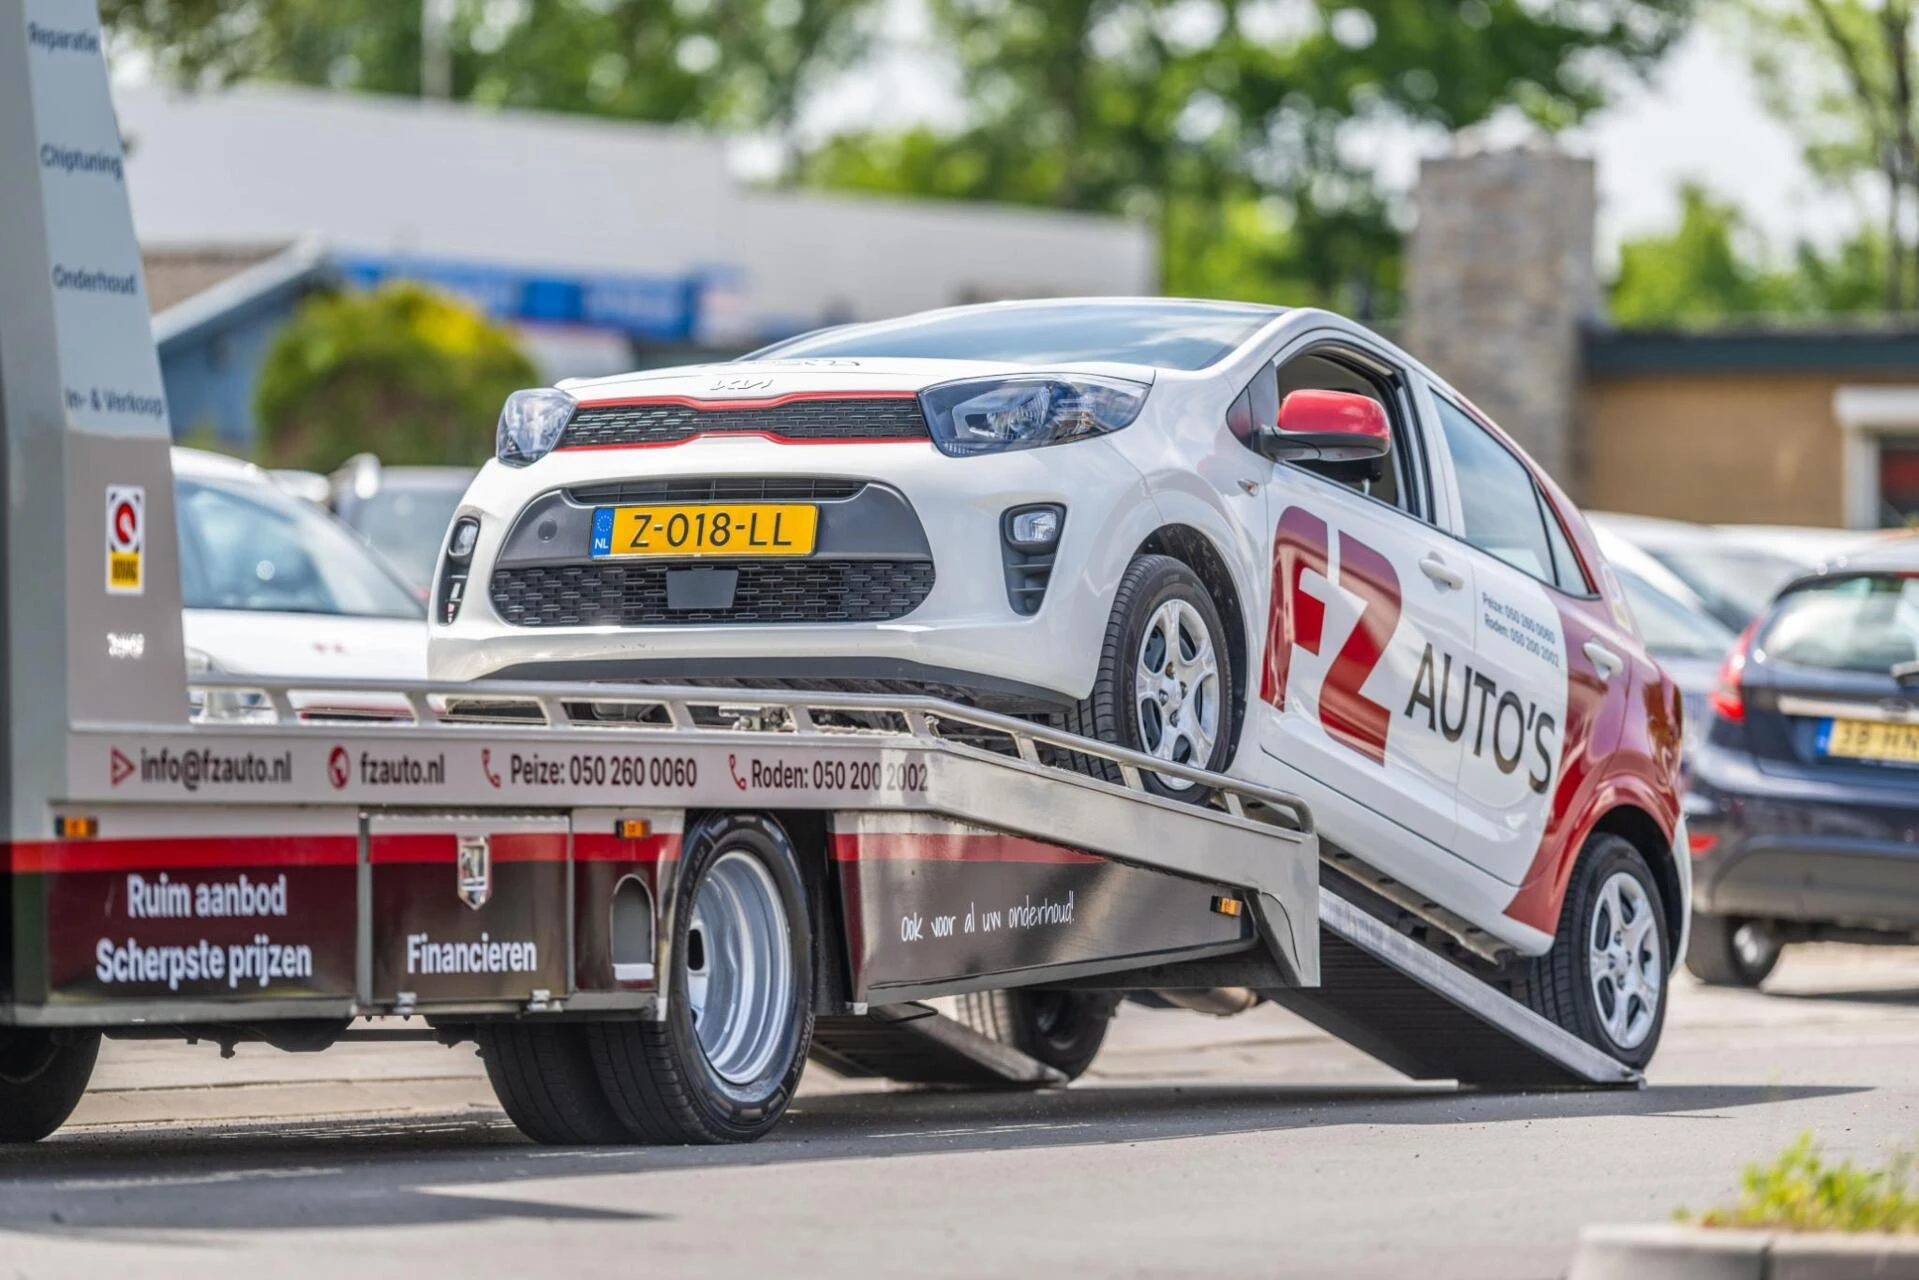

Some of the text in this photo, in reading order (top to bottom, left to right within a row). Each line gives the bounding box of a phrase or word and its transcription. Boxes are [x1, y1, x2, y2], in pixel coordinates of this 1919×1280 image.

[40, 143, 122, 180] Chiptuning
[53, 264, 136, 295] Onderhoud
[594, 538, 609, 550] NL
[630, 512, 792, 548] Z-018-LL
[1259, 505, 1402, 768] FZ
[1404, 642, 1556, 794] AUTO'S
[141, 747, 292, 791] info@fzauto.nl
[360, 751, 446, 785] fzauto.nl
[511, 754, 697, 788] Peize: 050 260 0060
[752, 759, 928, 792] Roden: 050 200 2002
[127, 873, 288, 918] Ruim aanbod
[931, 914, 956, 938] voor
[964, 901, 976, 934] al
[982, 909, 1002, 933] uw
[1008, 890, 1076, 930] onderhoud!
[96, 933, 313, 991] Scherpste prijzen
[407, 932, 537, 974] Financieren
